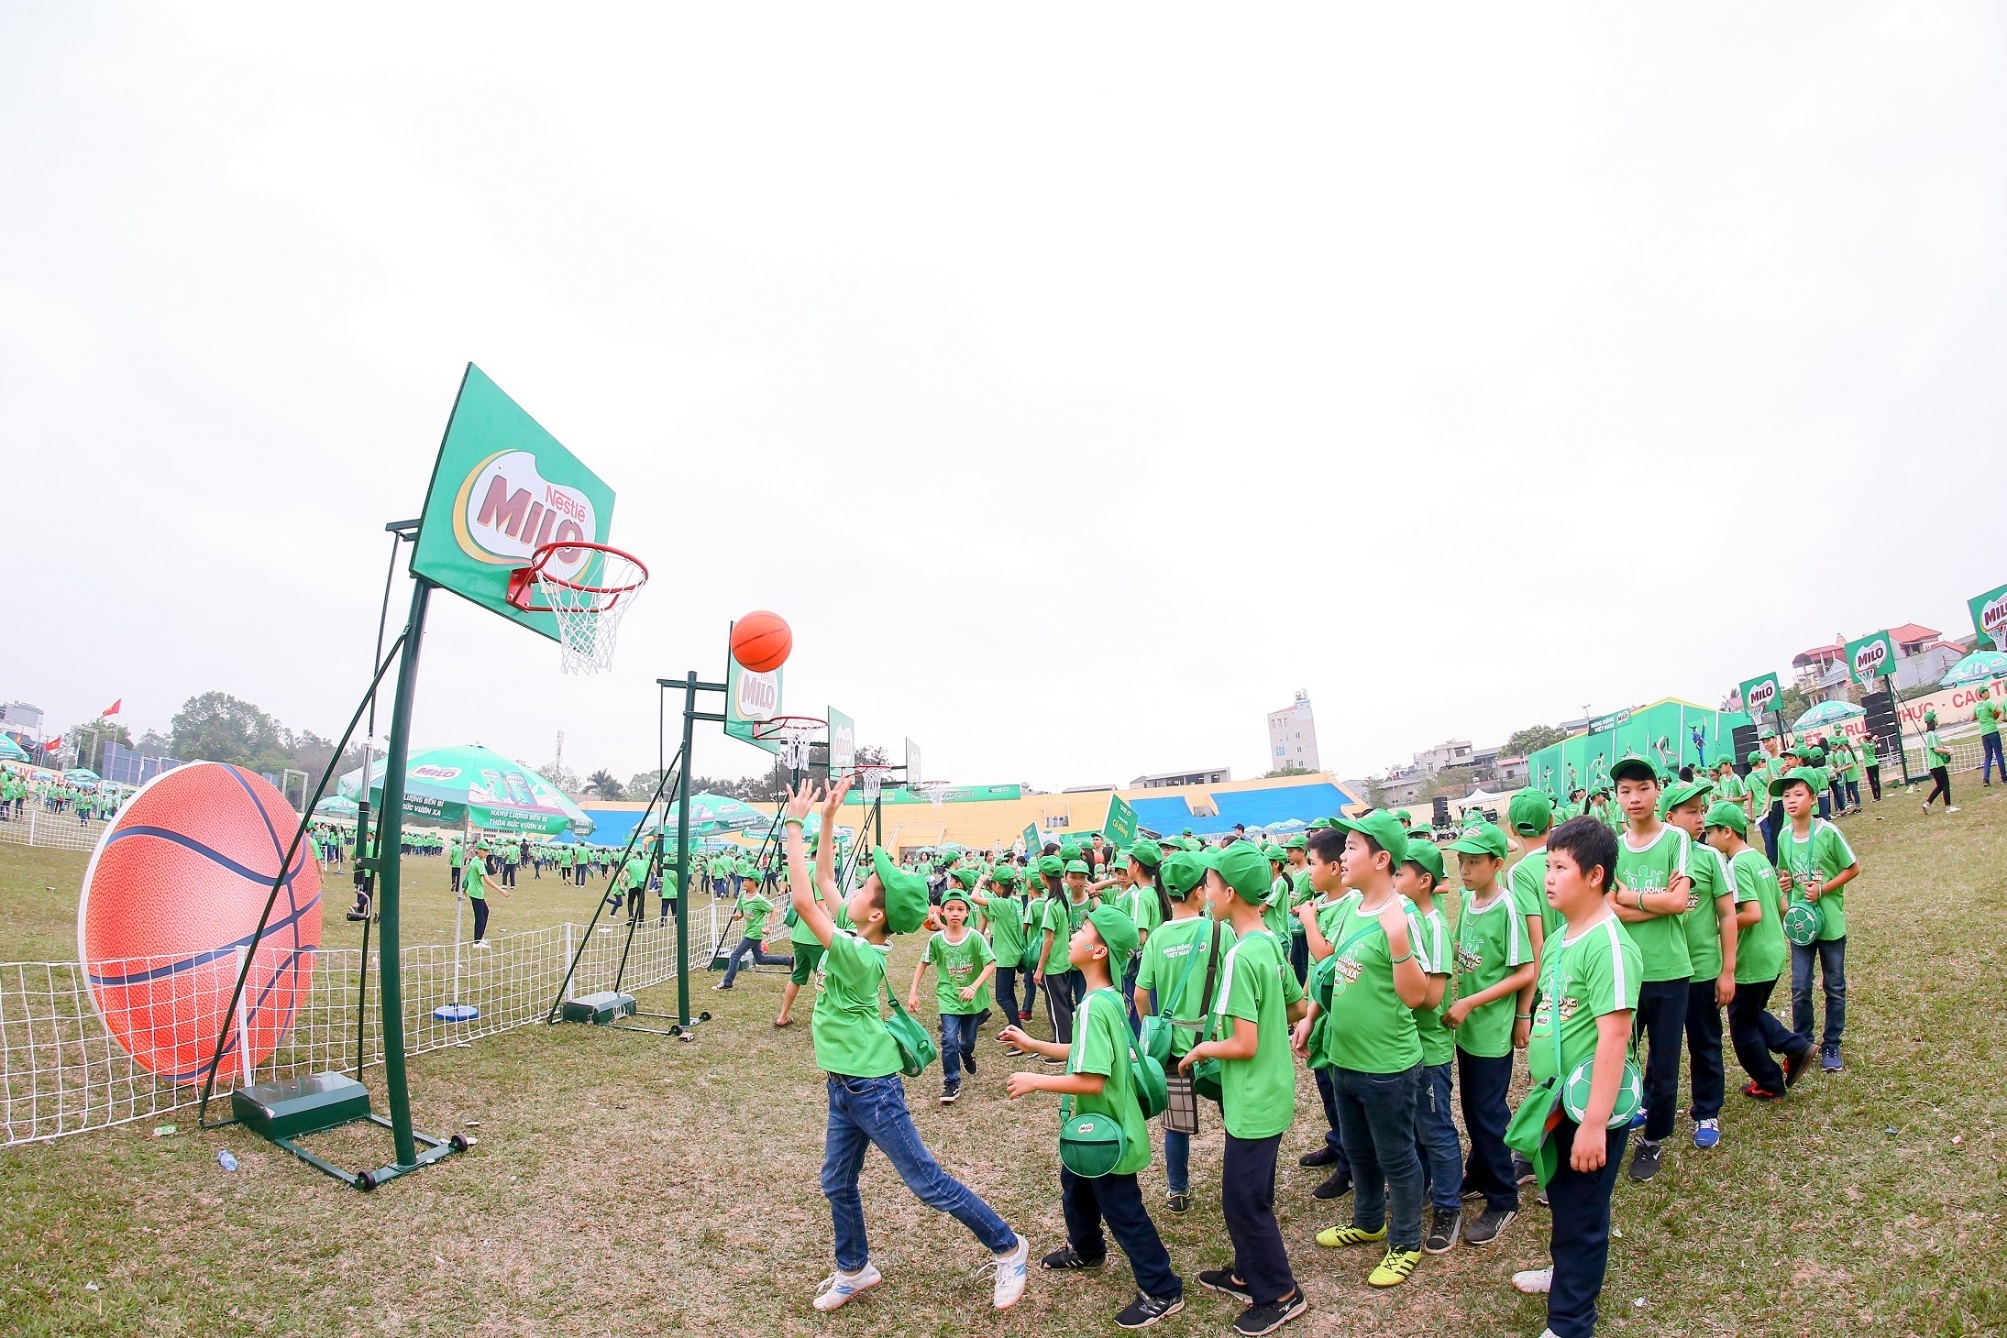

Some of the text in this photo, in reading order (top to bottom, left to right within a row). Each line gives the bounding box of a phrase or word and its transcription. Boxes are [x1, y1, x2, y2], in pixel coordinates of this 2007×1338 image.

[545, 485, 586, 523] Nestlé
[477, 474, 584, 567] MILO
[1857, 647, 1884, 667] MILO
[741, 674, 776, 710] MILO
[1750, 686, 1773, 704] MILO
[415, 767, 457, 778] MILO
